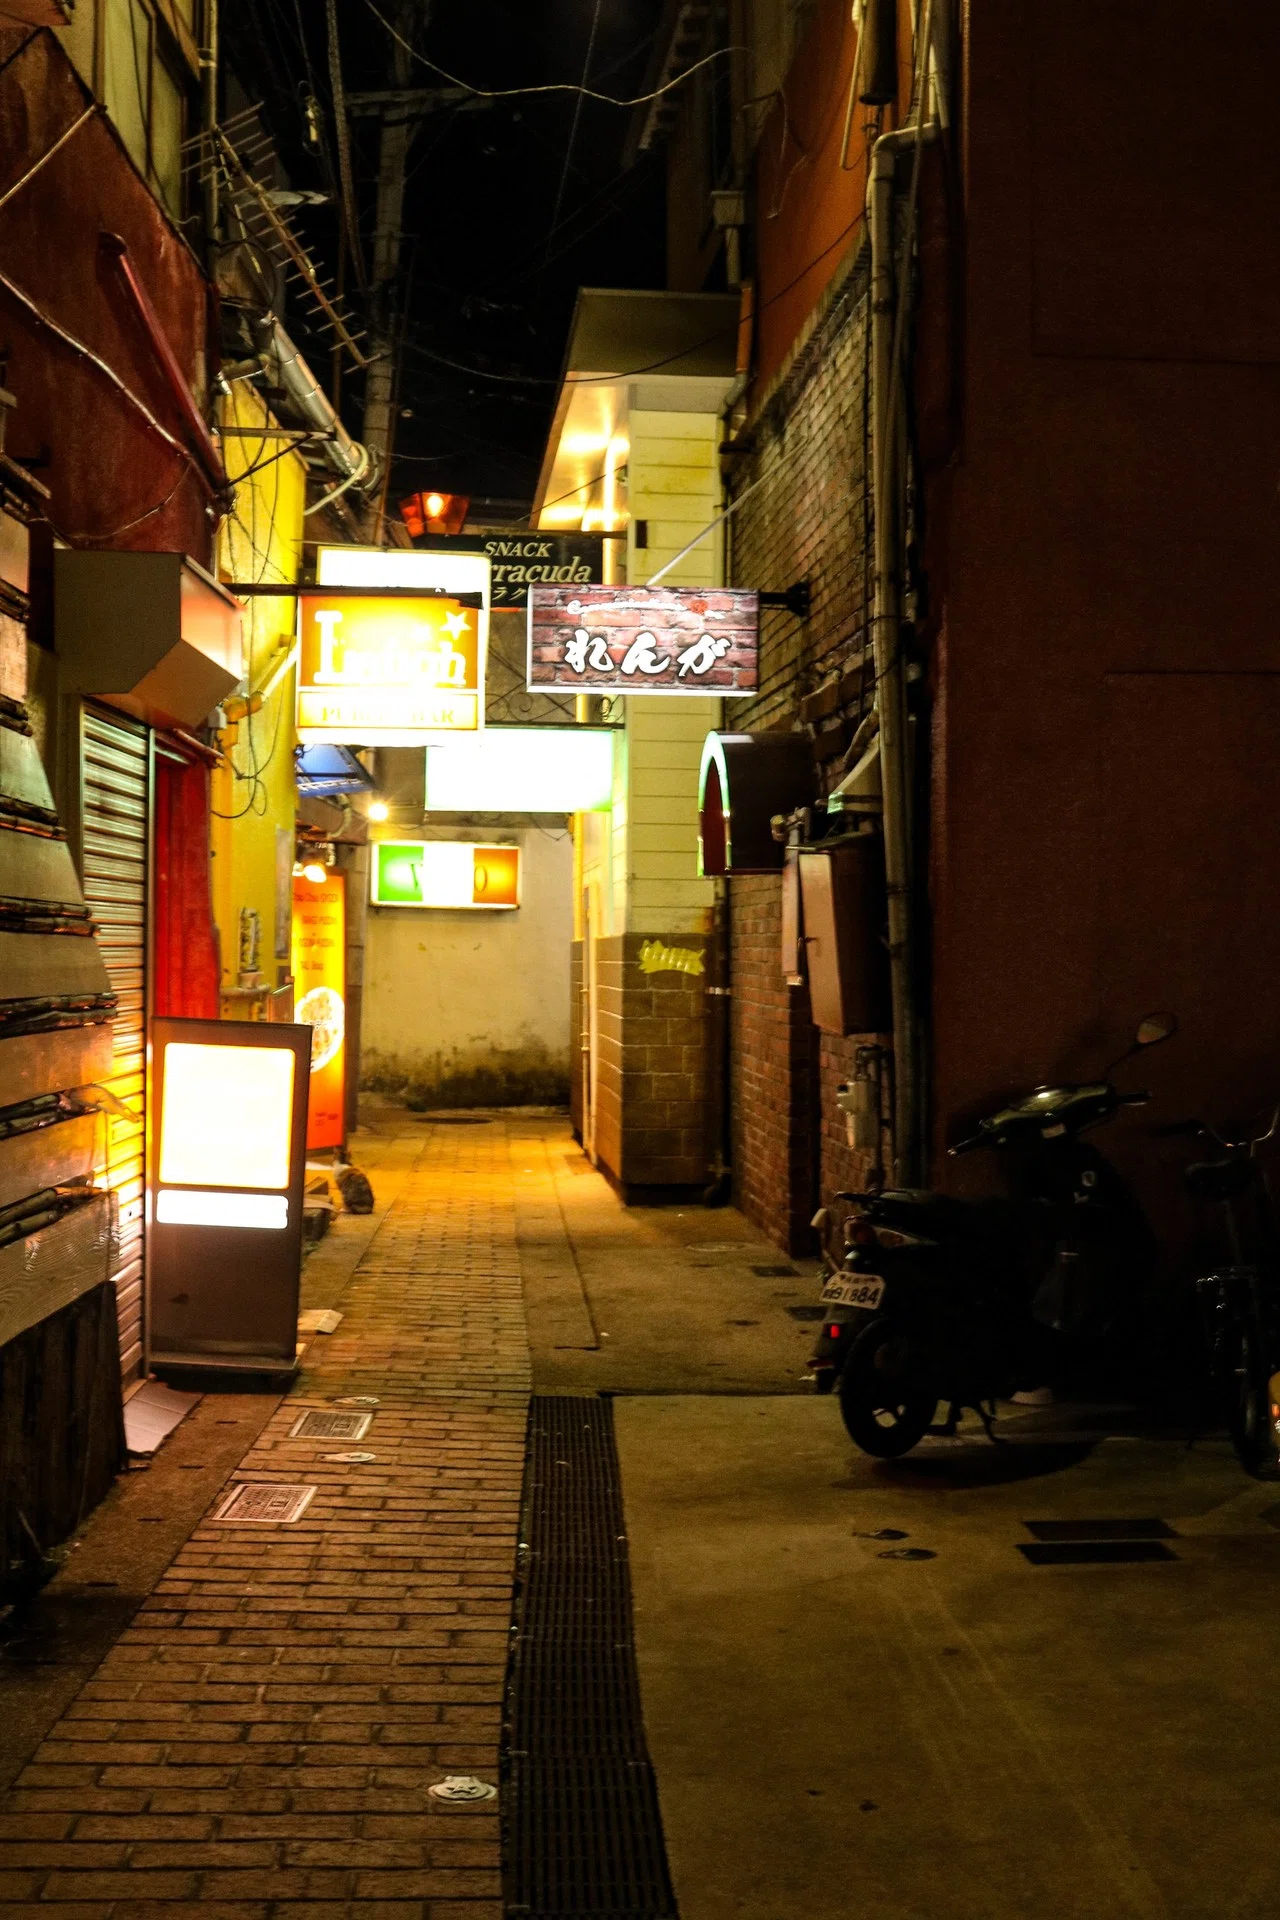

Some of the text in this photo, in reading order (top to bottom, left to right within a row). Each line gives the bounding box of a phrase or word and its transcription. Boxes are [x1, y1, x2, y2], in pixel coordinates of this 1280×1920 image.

[485, 541, 553, 557] SNACK
[564, 629, 731, 677] れんが
